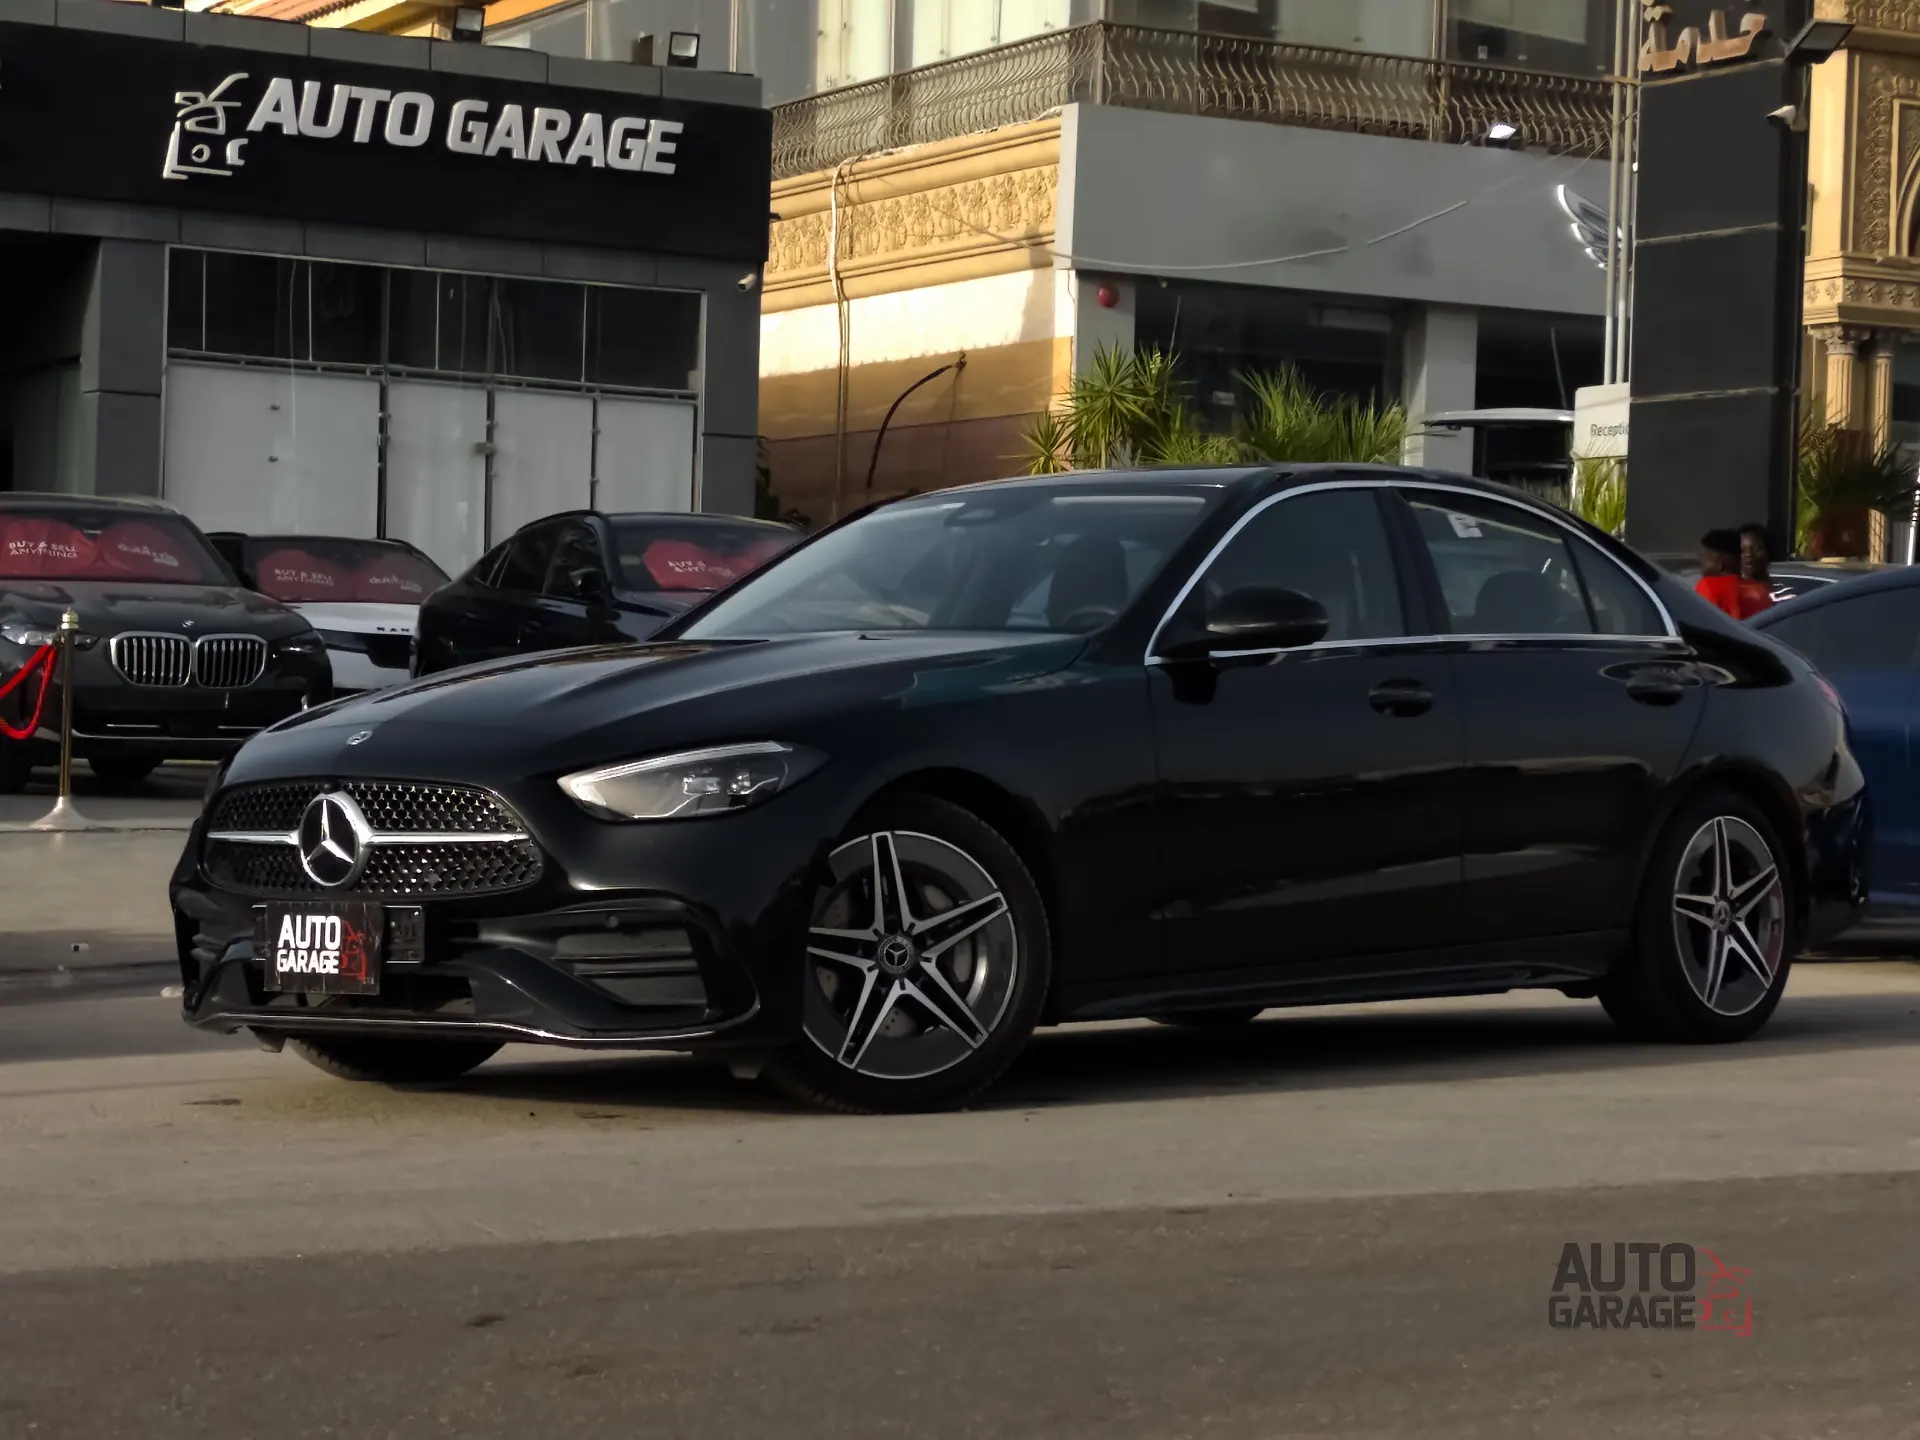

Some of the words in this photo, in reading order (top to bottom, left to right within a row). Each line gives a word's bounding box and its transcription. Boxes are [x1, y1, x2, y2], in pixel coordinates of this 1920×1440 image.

[246, 77, 435, 147] AUTO
[446, 98, 684, 175] GARAGE
[277, 914, 341, 950] AUTO
[276, 949, 340, 974] GARAGE
